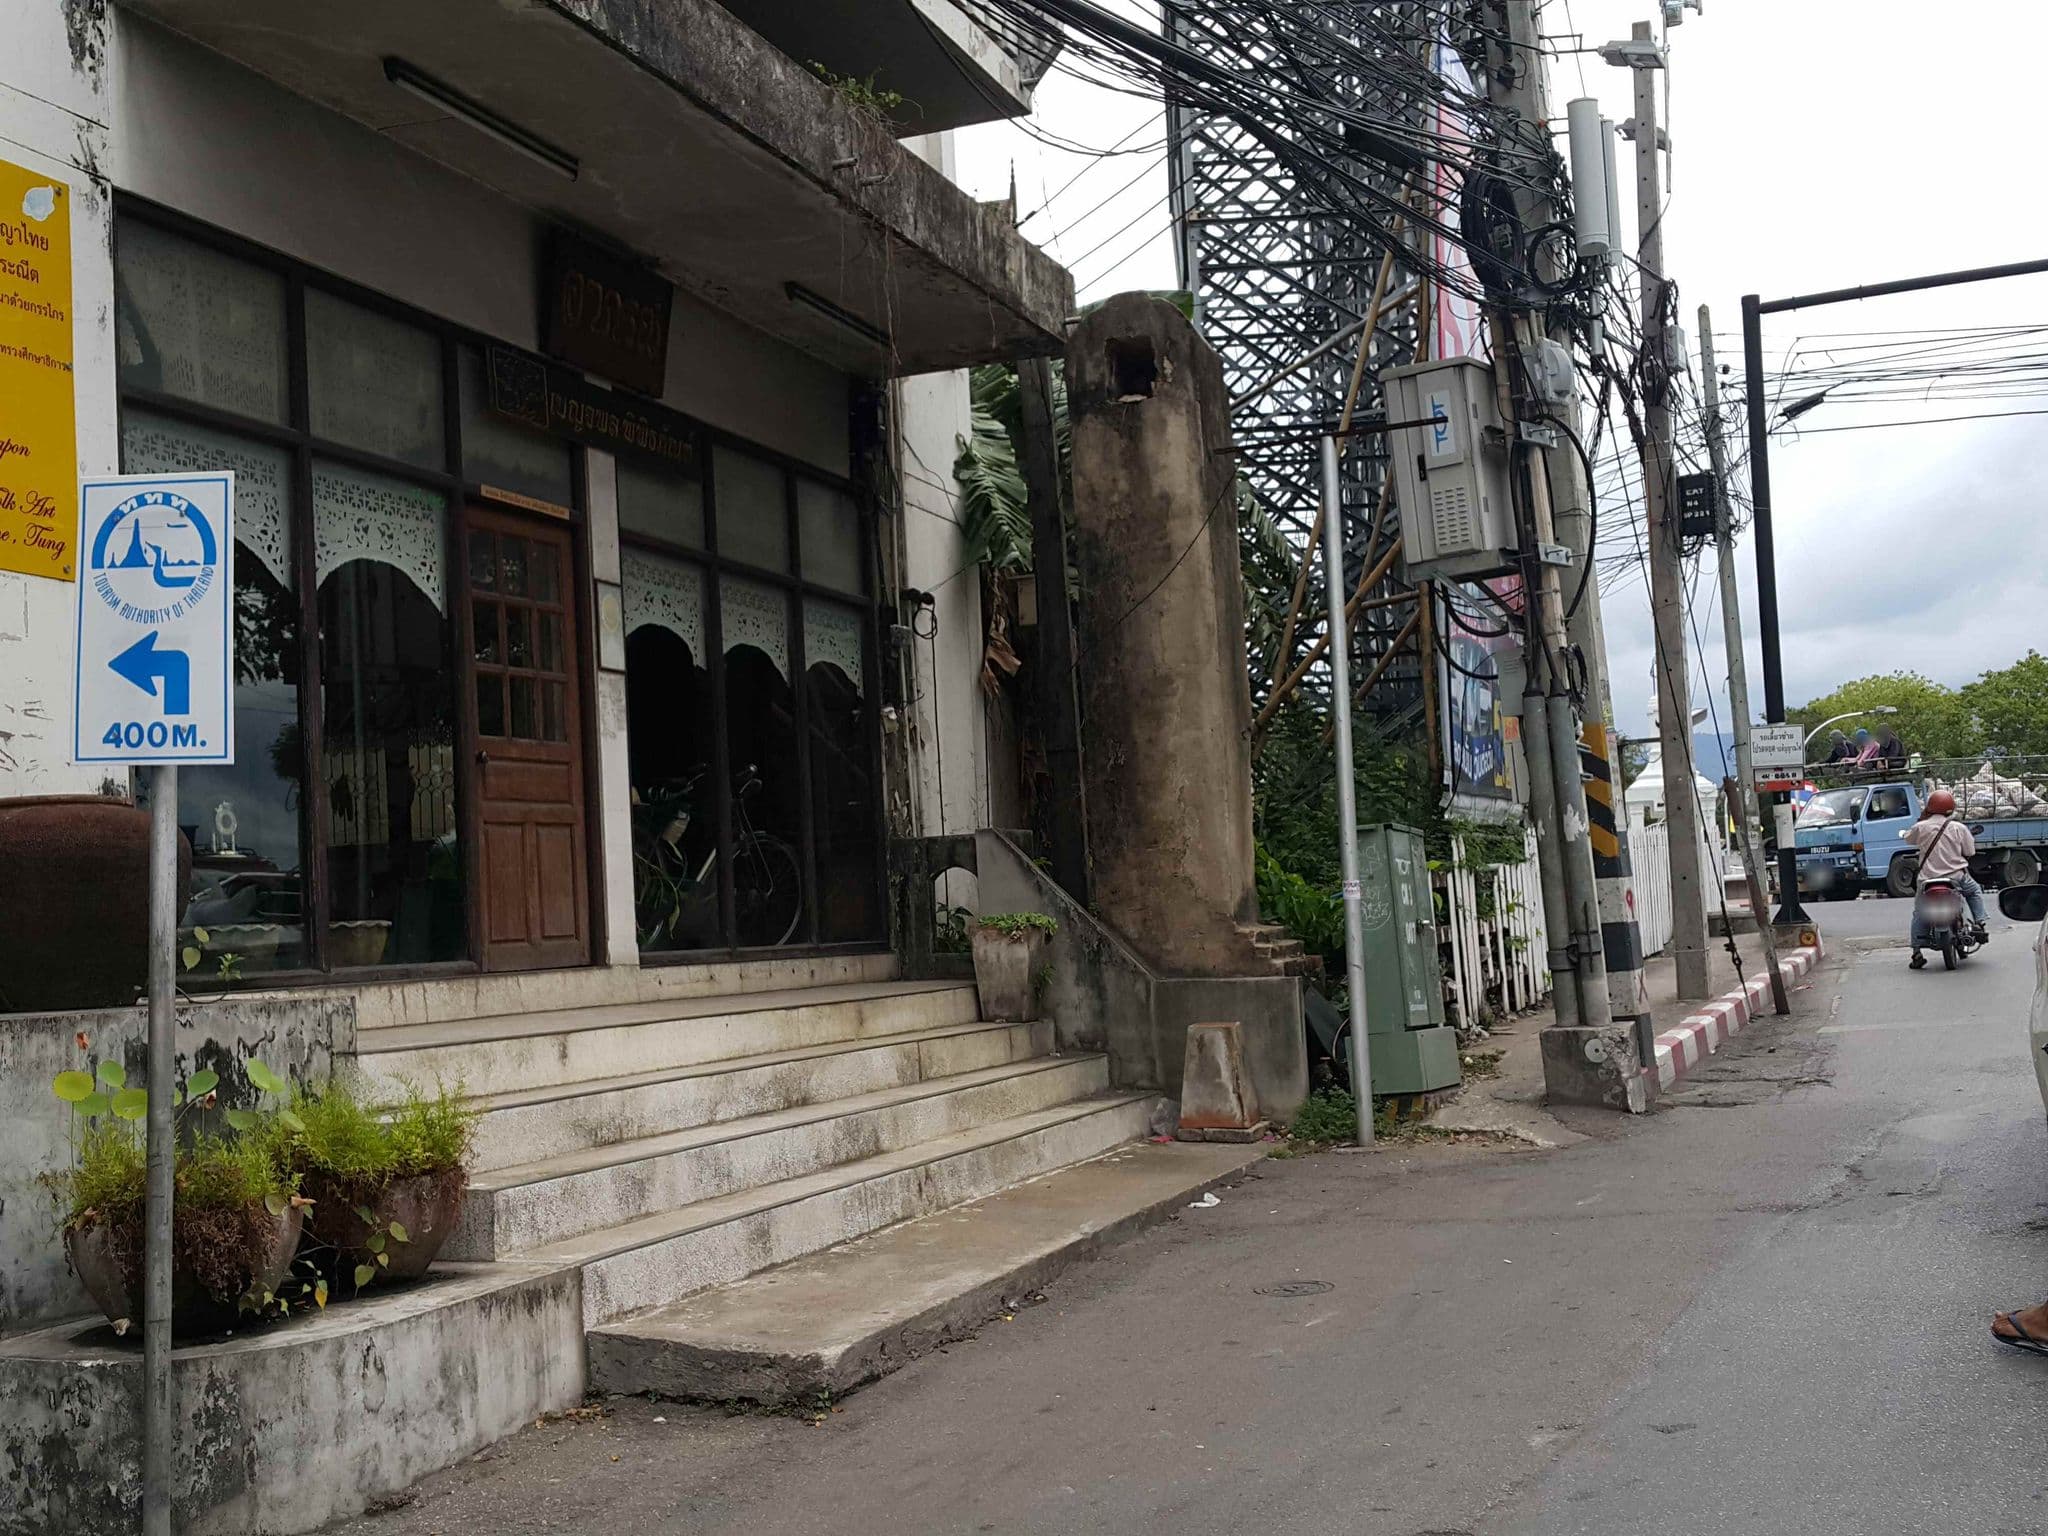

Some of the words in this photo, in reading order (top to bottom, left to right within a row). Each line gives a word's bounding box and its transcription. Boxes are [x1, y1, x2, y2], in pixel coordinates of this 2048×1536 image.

[1431, 395, 1448, 454] TOT
[19, 490, 56, 519] Art
[1685, 487, 1704, 496] CAT
[23, 522, 67, 561] Tung
[92, 571, 122, 612] TOURISM
[119, 601, 172, 625] AUTHORITY
[171, 604, 186, 619] OF
[183, 566, 215, 610] THAILAND
[1810, 846, 1830, 854] ISUZU
